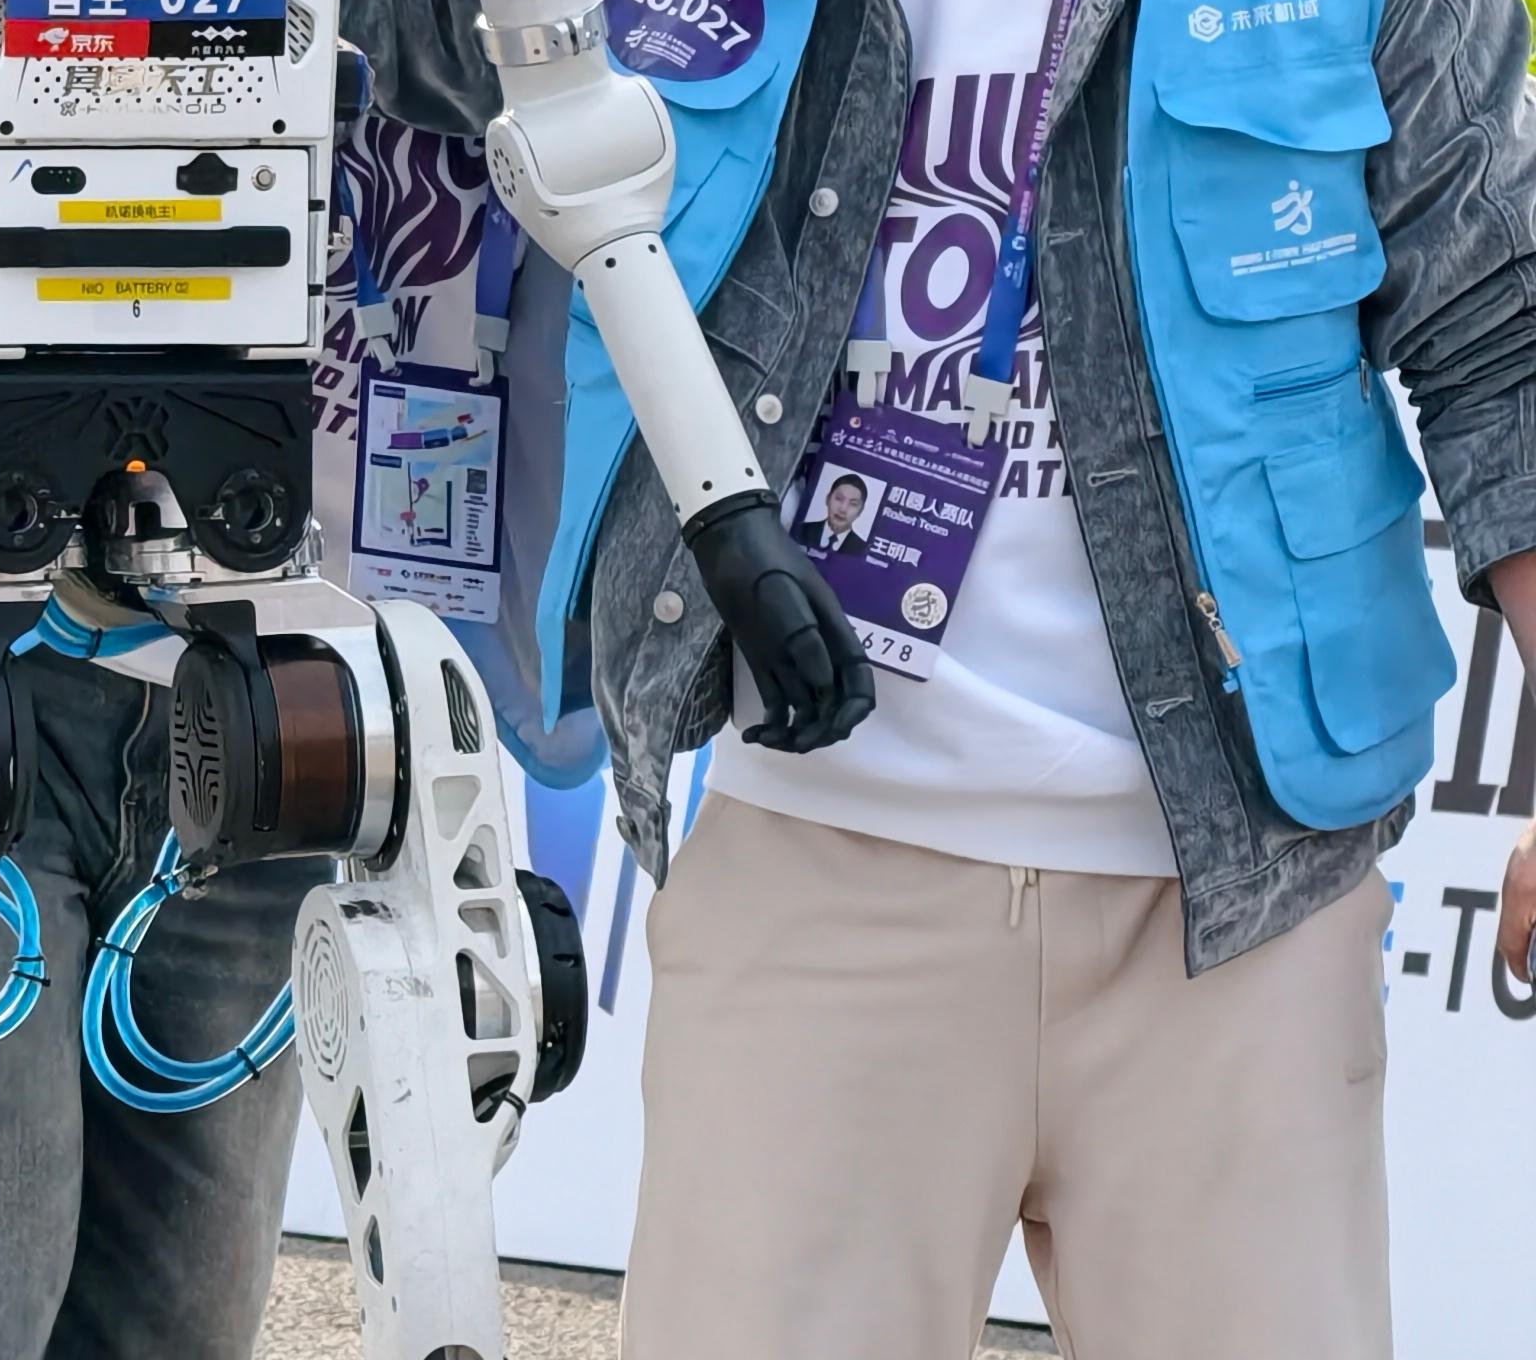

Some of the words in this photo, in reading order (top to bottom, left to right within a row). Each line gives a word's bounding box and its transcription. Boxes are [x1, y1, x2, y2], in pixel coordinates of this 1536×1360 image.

[70, 34, 115, 53] 京东
[115, 281, 172, 295] BATTERY
[132, 298, 142, 319] 6
[882, 506, 917, 527] Robot
